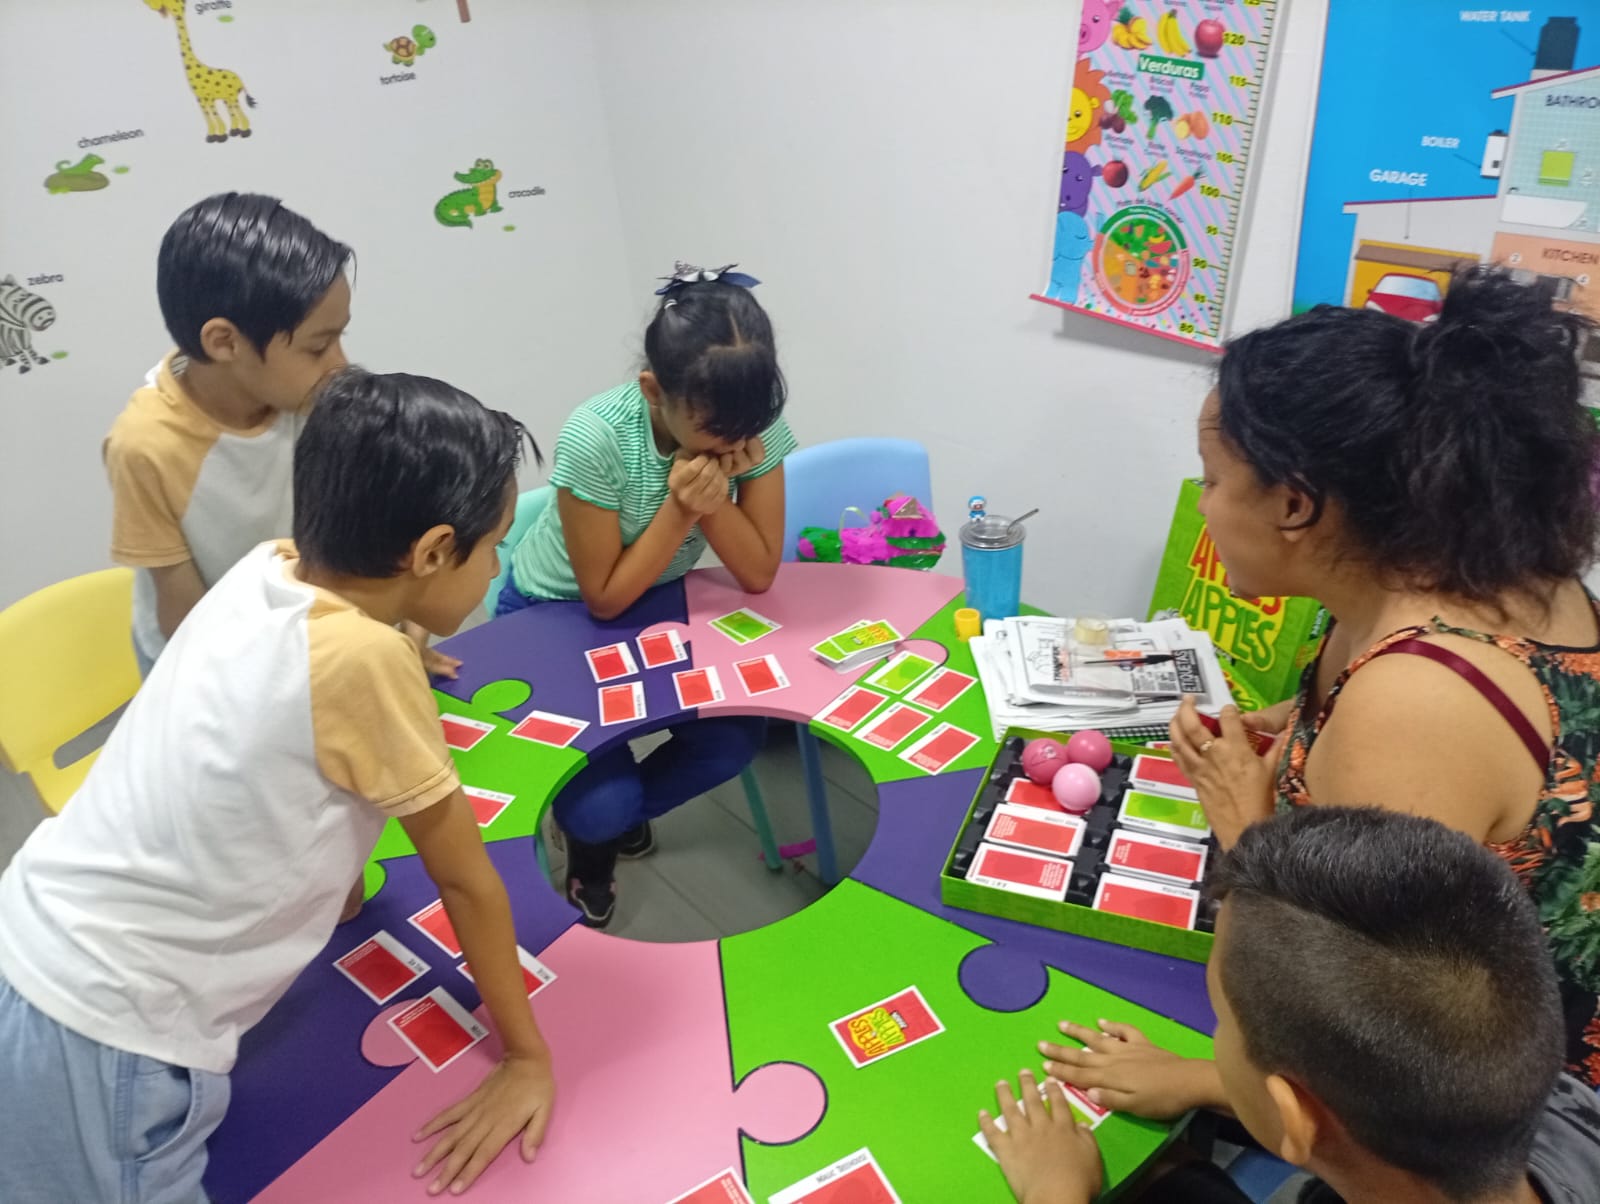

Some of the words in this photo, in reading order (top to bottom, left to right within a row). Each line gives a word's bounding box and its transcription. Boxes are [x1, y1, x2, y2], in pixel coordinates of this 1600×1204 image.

[1460, 10, 1498, 22] WATER
[1500, 10, 1531, 22] TANK
[1223, 33, 1246, 46] 120
[1140, 57, 1199, 79] Verduras
[78, 129, 144, 148] chameleon
[1421, 135, 1460, 149] BOILER
[1369, 168, 1428, 187] GARAGE
[508, 186, 546, 198] crocodile
[1542, 248, 1599, 264] KITCHEN
[27, 273, 64, 286] zebra
[1181, 578, 1275, 669] APPLES
[1175, 651, 1195, 692] ETIQUETAS
